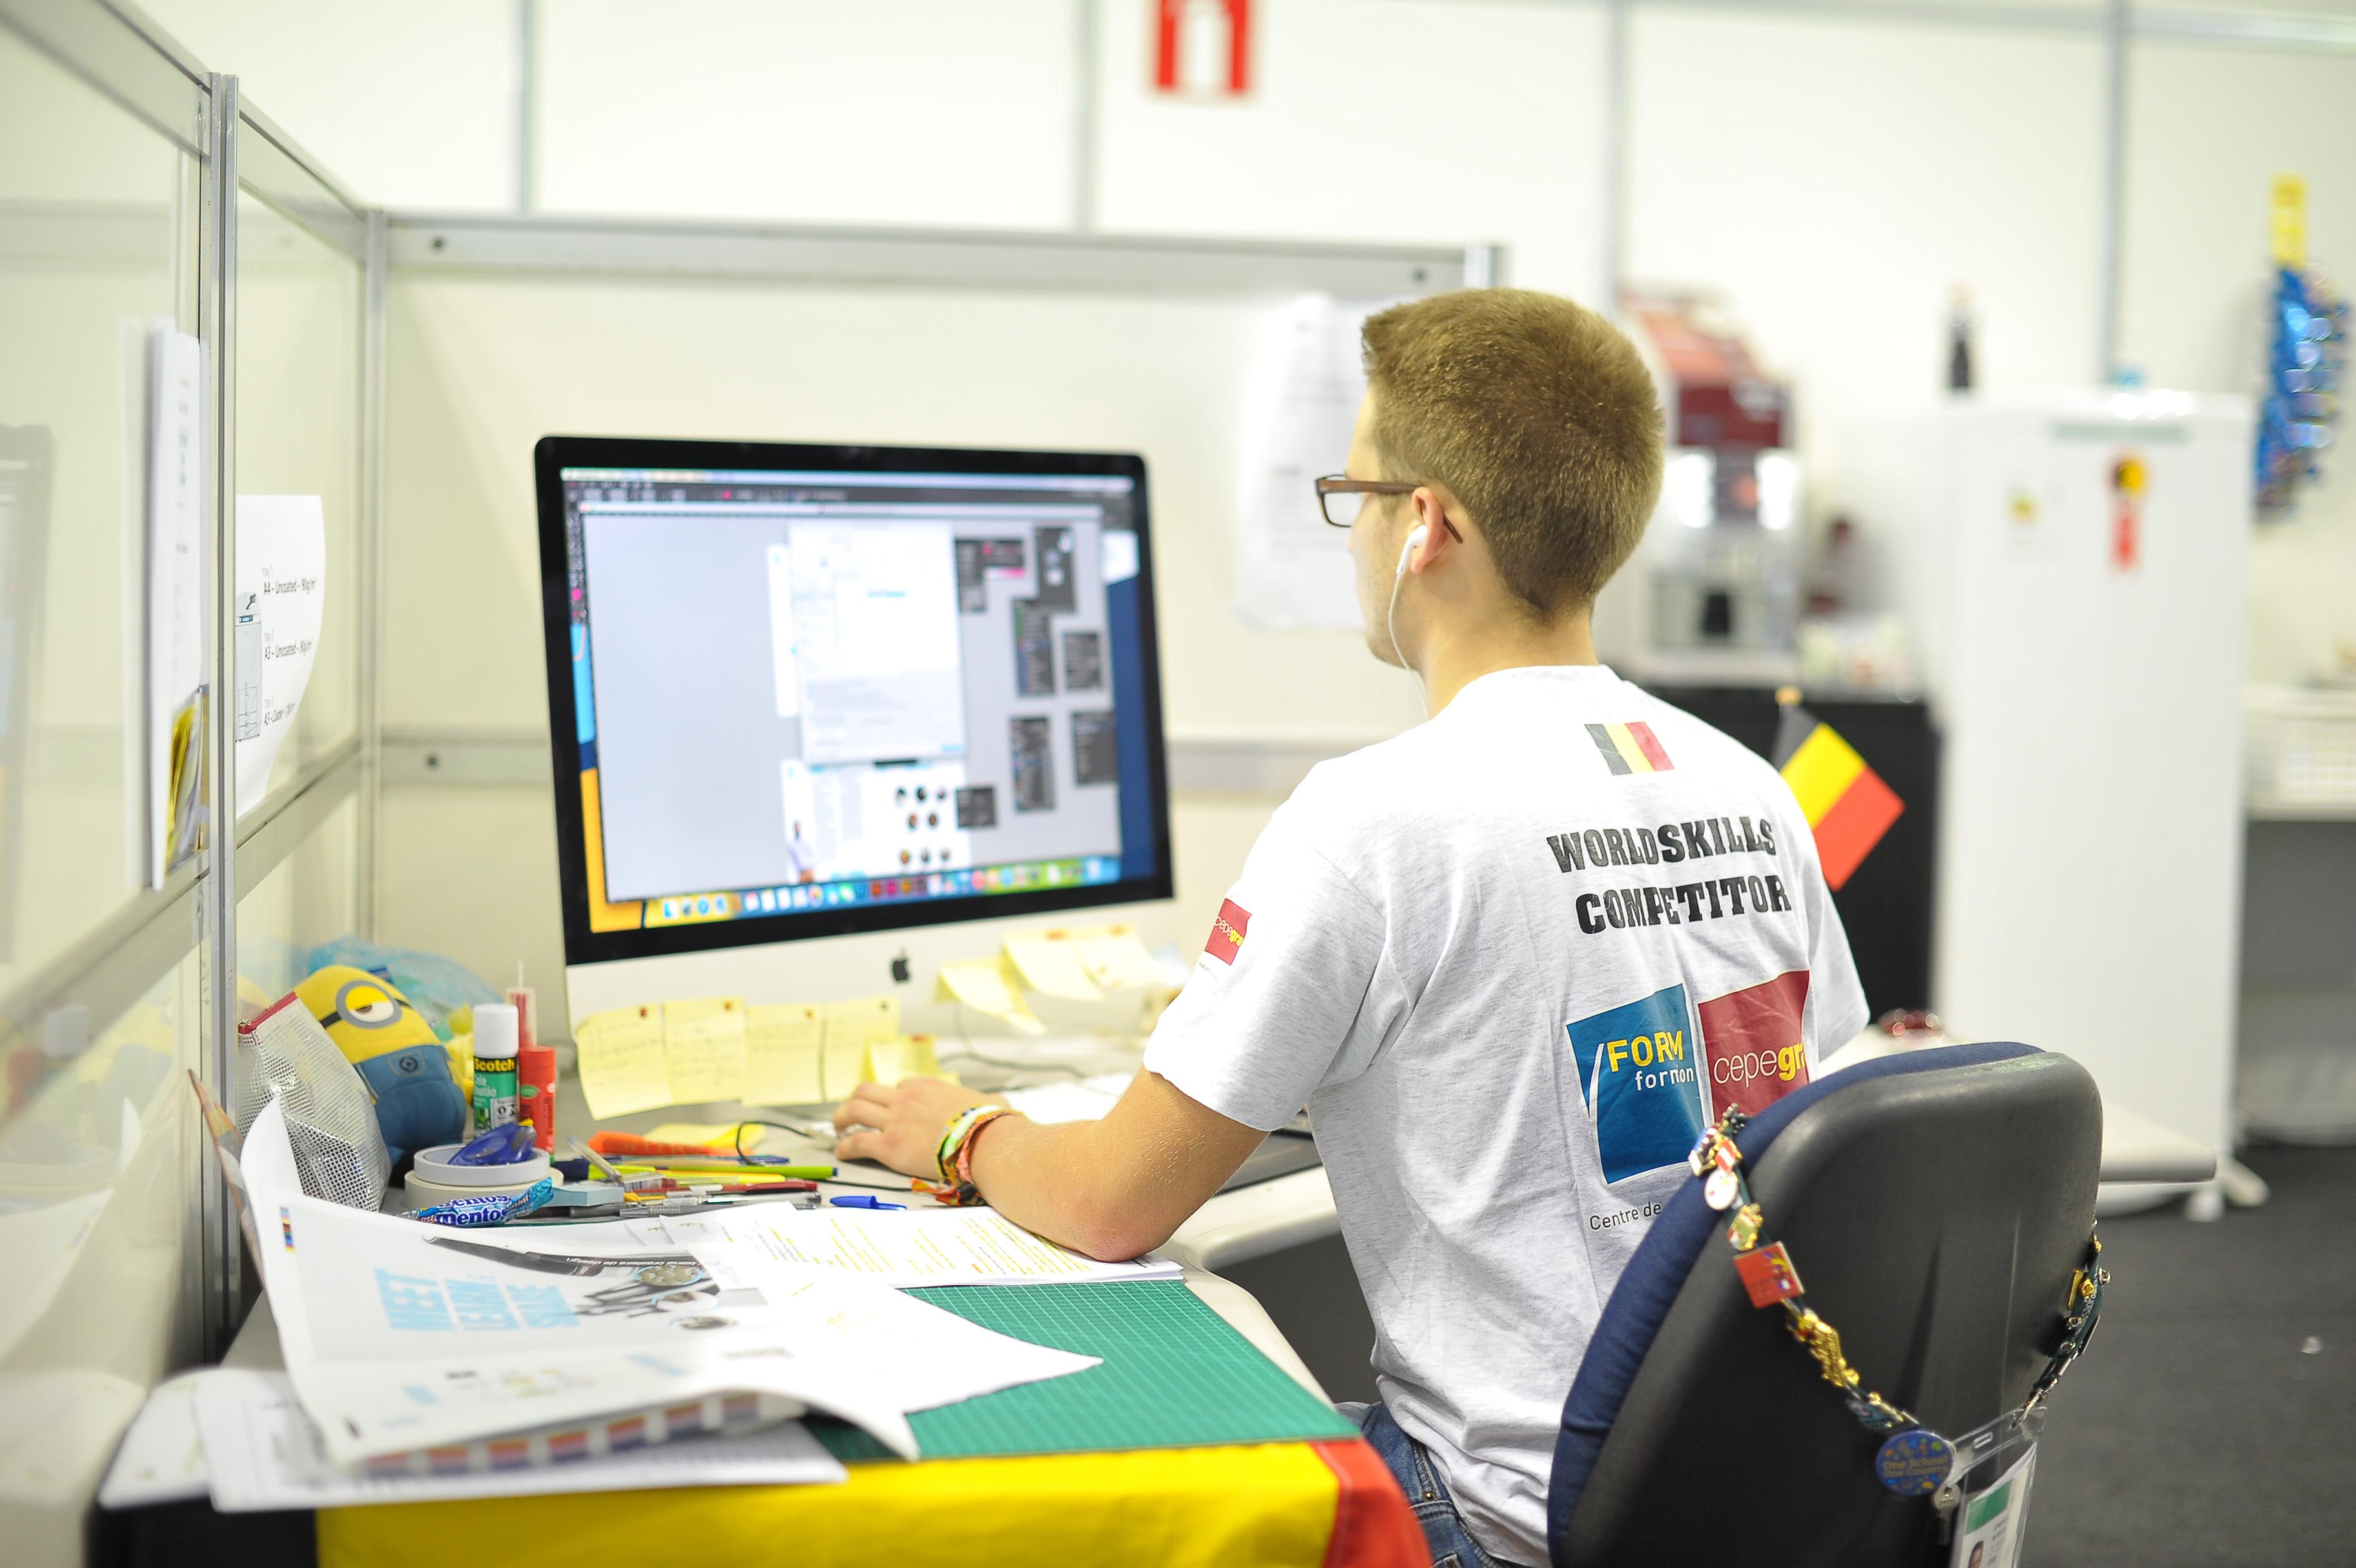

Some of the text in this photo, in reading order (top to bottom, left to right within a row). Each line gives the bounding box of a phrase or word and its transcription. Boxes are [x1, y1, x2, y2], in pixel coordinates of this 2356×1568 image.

[1546, 816, 1776, 874] WORLDSKILLS
[1576, 875, 1792, 934] COMPETITOR
[1215, 916, 1243, 947] cepegra
[474, 1058, 515, 1072] Scotch
[436, 1207, 509, 1226] mentos
[1590, 1201, 1662, 1230] Centre de
